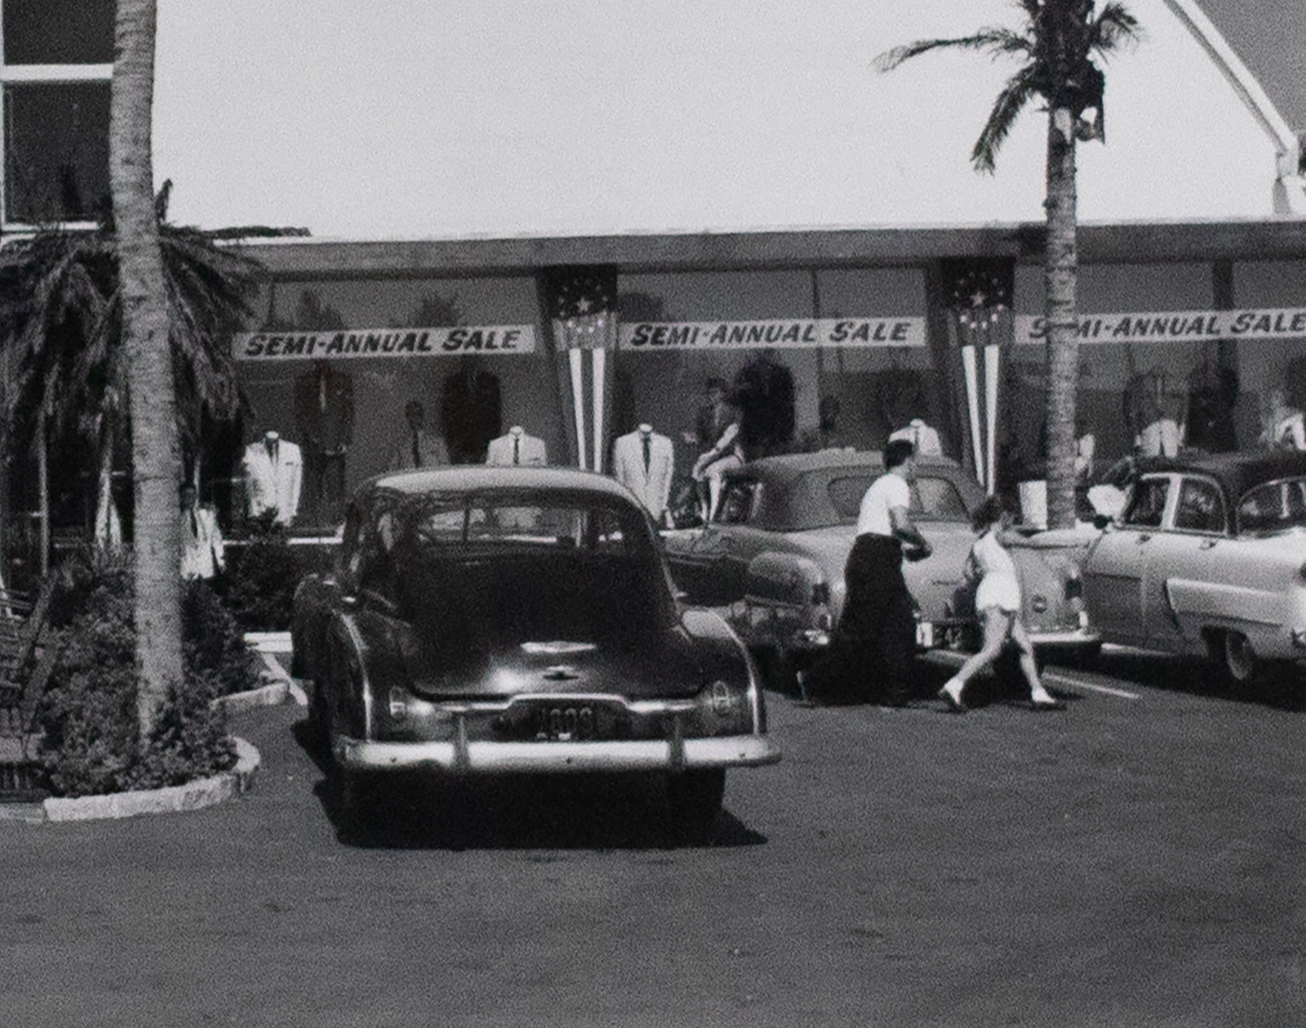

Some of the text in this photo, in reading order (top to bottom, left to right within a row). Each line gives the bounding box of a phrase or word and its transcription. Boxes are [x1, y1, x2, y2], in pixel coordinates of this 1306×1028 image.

[630, 321, 912, 346] SEMI-ANNUAL SALE
[1027, 316, 1222, 339] SMI-ANNUAL
[244, 329, 522, 356] SEMI-ANNUAL SALE
